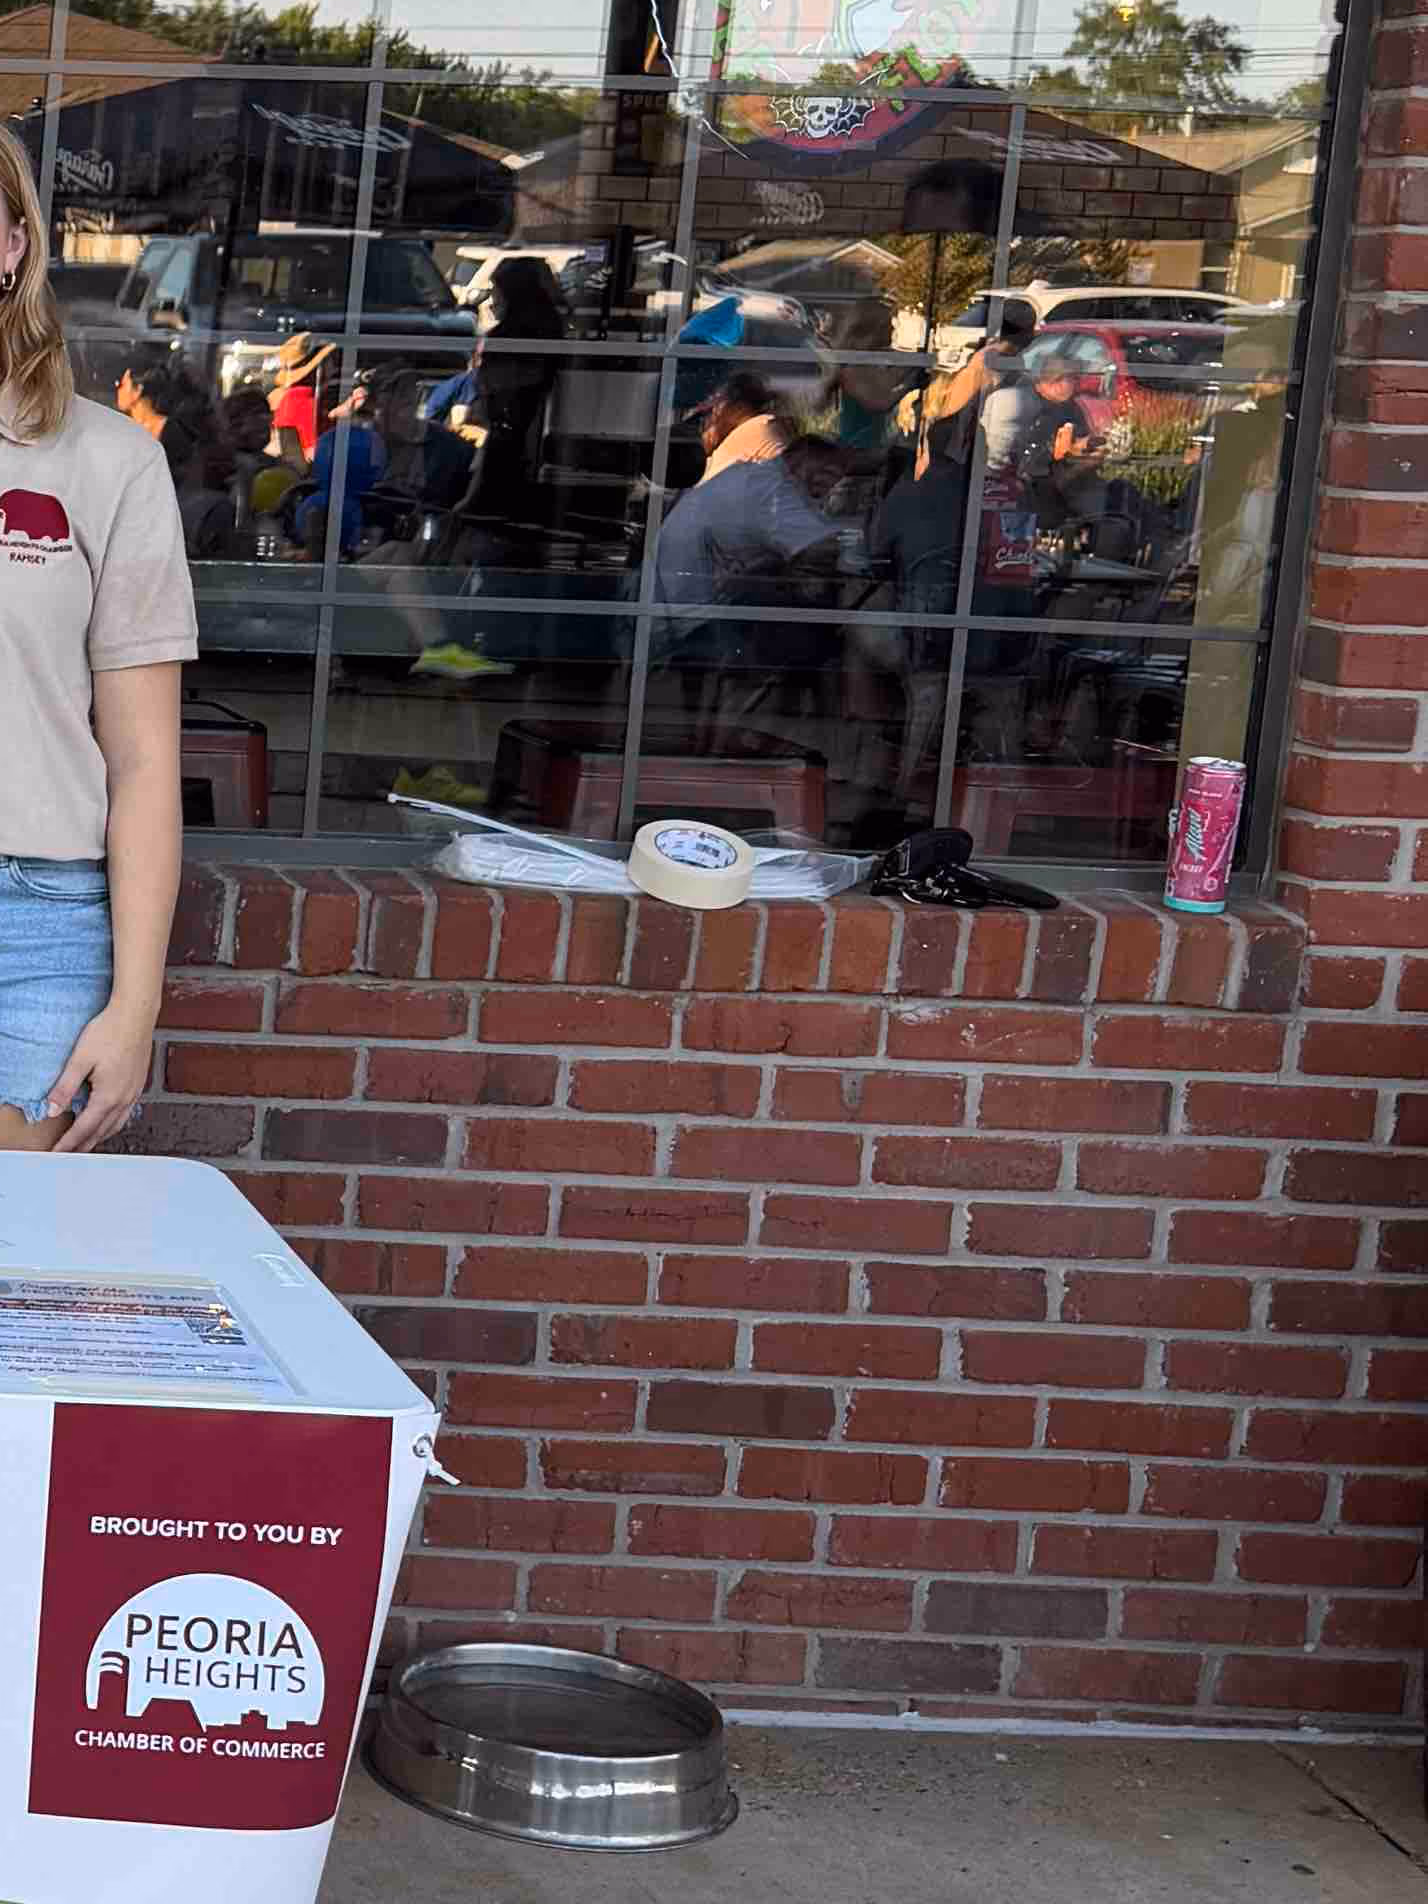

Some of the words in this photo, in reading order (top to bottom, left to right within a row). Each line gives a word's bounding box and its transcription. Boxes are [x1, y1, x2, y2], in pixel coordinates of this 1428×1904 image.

[90, 1515, 209, 1539] BROUGHT
[214, 1521, 247, 1541] TO
[253, 1524, 304, 1544] YOU
[310, 1526, 344, 1546] BY
[125, 1612, 304, 1659] PEORIA
[145, 1656, 306, 1694] HEIGHTS
[74, 1729, 174, 1752] CHAMBER
[179, 1736, 208, 1754] OF
[212, 1738, 326, 1759] COMMERCE
